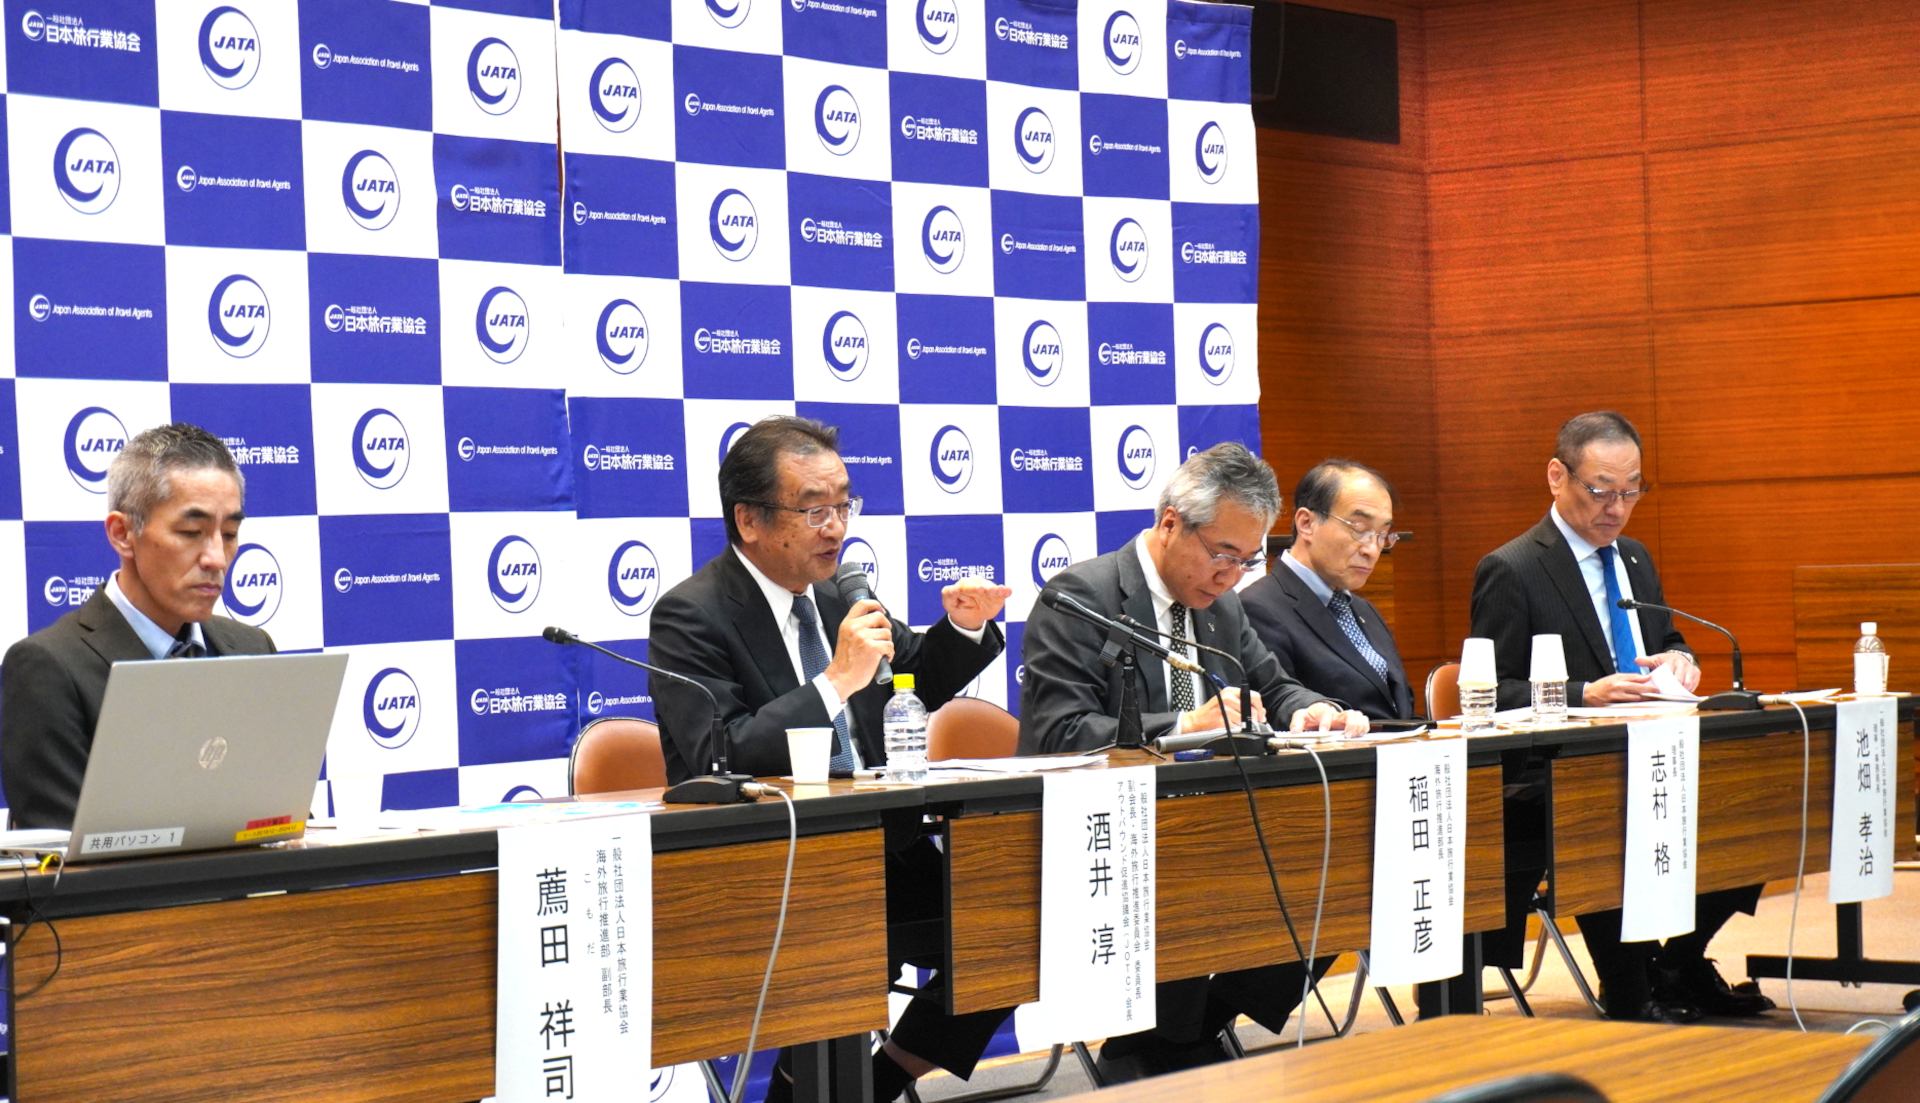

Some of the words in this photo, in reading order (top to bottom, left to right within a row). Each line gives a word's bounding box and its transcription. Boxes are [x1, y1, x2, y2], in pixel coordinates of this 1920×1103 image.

[46, 15, 83, 26] 一般社団法人
[927, 10, 955, 24] JATA
[46, 24, 140, 52] 日本旅行業協会
[214, 36, 255, 52] JATA
[1010, 28, 1068, 49] 日本旅行業協会
[1113, 34, 1139, 46] JATA
[333, 54, 350, 64] Japan
[350, 55, 379, 66] Association
[380, 59, 386, 67] of
[386, 59, 401, 69] Travel
[402, 61, 418, 73] Agents
[481, 65, 516, 80] JATA
[603, 84, 637, 99] JATA
[826, 110, 857, 124] JATA
[917, 126, 977, 145] 日本旅行業協会
[1025, 131, 1052, 143] JATA
[1204, 144, 1224, 155] JATA
[70, 159, 114, 174] JATA
[198, 176, 216, 186] Japan
[216, 177, 248, 187] Association
[249, 179, 256, 188] of
[256, 179, 270, 188] Travel
[272, 180, 291, 191] Agents
[356, 179, 395, 194] JATA
[470, 196, 546, 217] 日本旅行業協会
[722, 214, 754, 228] JATA
[817, 229, 882, 248] 日本旅行業協会
[932, 230, 961, 242] JATA
[1120, 241, 1145, 252] JATA
[1194, 250, 1247, 264] 日本旅行業協会
[52, 304, 71, 316] Japan
[72, 305, 106, 316] Association
[108, 307, 114, 316] of
[115, 307, 131, 317] Travel
[132, 308, 152, 320] Agents
[224, 304, 265, 318] JATA
[344, 315, 426, 334] 日本旅行業協会
[490, 314, 524, 328] JATA
[610, 326, 644, 339] JATA
[712, 338, 780, 354] 日本旅行業協会
[834, 336, 864, 348] JATA
[1032, 344, 1060, 355] JATA
[1112, 351, 1166, 364] 日本旅行業協会
[1208, 345, 1232, 356] JATA
[81, 438, 124, 452] JATA
[366, 437, 404, 450] JATA
[476, 446, 492, 455] Japan
[492, 446, 520, 454] Association
[520, 446, 526, 454] of
[526, 446, 540, 454] Travel
[540, 446, 558, 456] Agents
[941, 450, 970, 461] JATA
[1126, 448, 1152, 459] JATA
[601, 454, 674, 470] 日本旅行業協会
[1025, 457, 1082, 471] 日本旅行業協会
[501, 563, 537, 576] JATA
[1042, 557, 1068, 568] JATA
[236, 572, 277, 588] JATA
[354, 576, 370, 585] Japan
[371, 574, 400, 583] Association
[401, 574, 408, 582] of
[408, 573, 421, 582] Travel
[422, 573, 440, 584] Agents
[621, 567, 655, 580] JATA
[378, 695, 416, 711] JATA
[490, 692, 566, 714] 日本旅行業協会
[1856, 728, 1871, 793] 池畑
[1651, 750, 1668, 820] 志村
[1409, 776, 1429, 851] 稲田
[90, 834, 160, 850] 共用パソコン
[170, 832, 175, 842] 1
[1859, 812, 1874, 876] 孝治
[1087, 812, 1113, 898] 酒井
[1654, 842, 1670, 876] 格
[596, 849, 610, 958] 海外旅行推進部
[536, 866, 569, 968] 薦田
[1413, 878, 1432, 954] 正彦
[612, 836, 628, 1034] 一般社団法人日本旅行業協会
[1092, 923, 1116, 966] 淳
[602, 967, 612, 1014] 副部長
[540, 999, 575, 1100] 祥司
